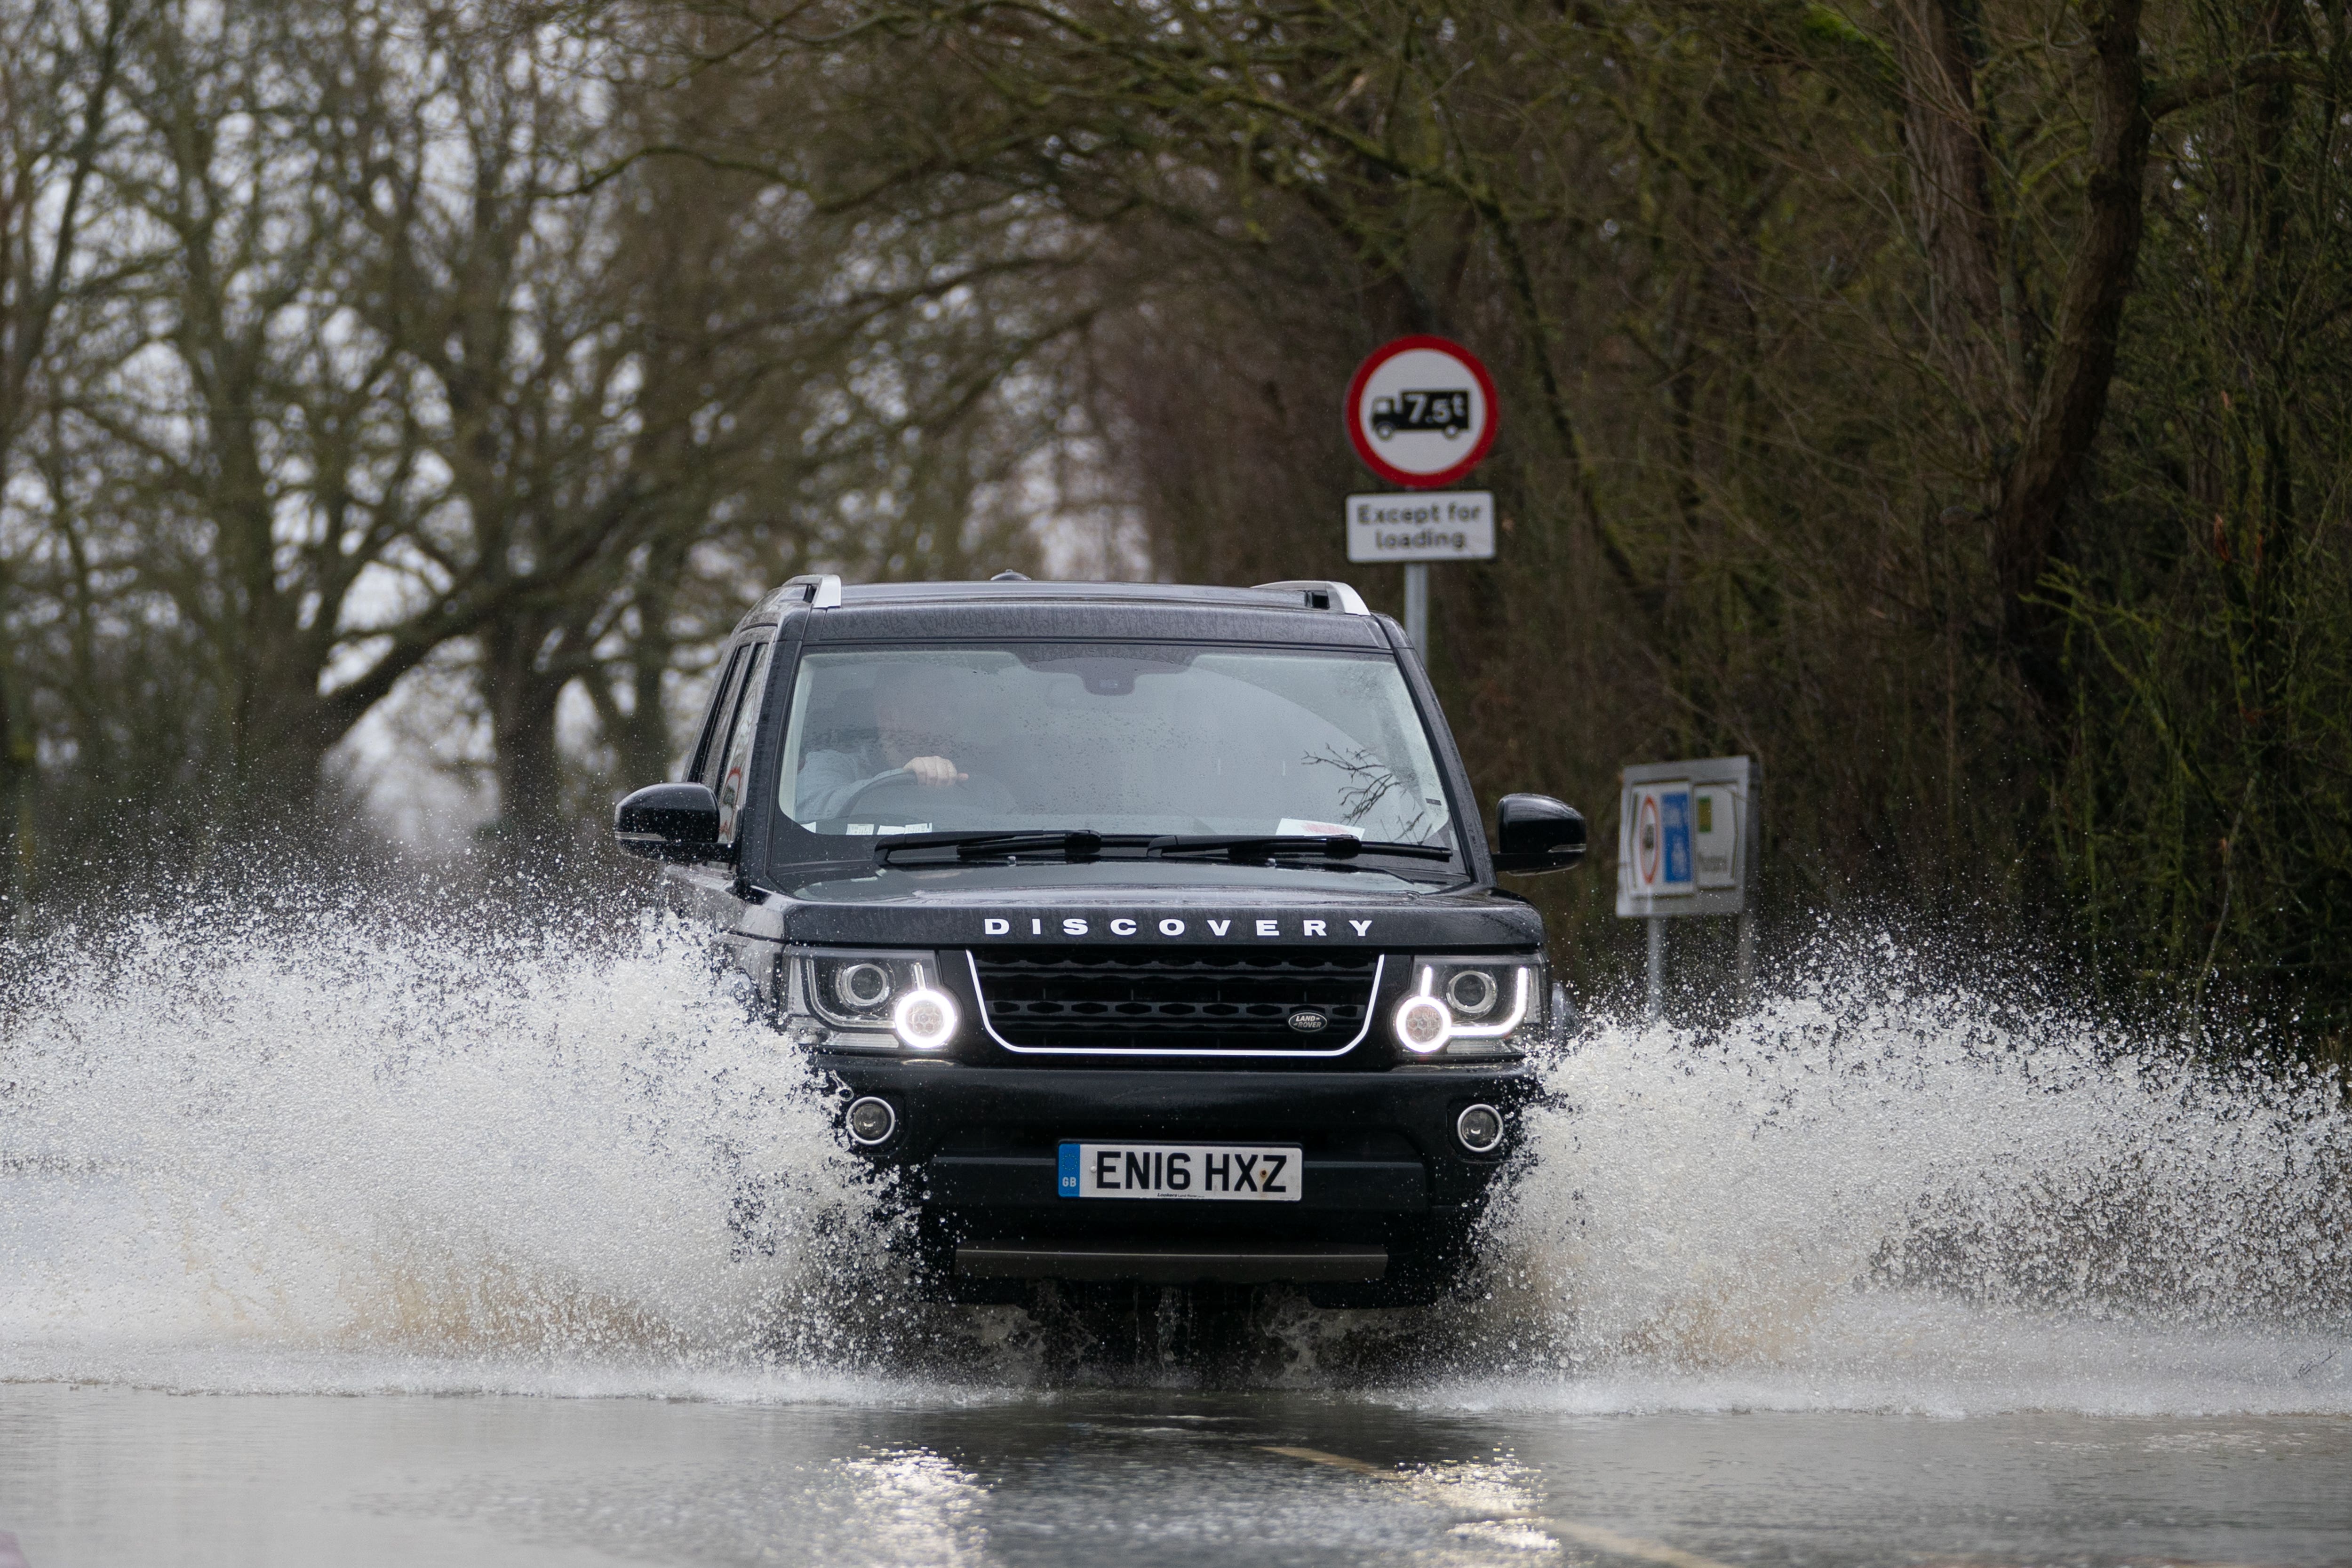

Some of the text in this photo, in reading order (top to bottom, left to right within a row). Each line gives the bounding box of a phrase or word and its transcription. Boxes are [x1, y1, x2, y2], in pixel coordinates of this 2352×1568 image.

[1405, 393, 1466, 423] 7.5t
[1356, 502, 1481, 525] Except for
[1375, 530, 1467, 550] loading
[984, 918, 1372, 937] DISCOVERY
[1062, 1177, 1076, 1187] GB
[1096, 1151, 1287, 1193] EN16 HXZ
